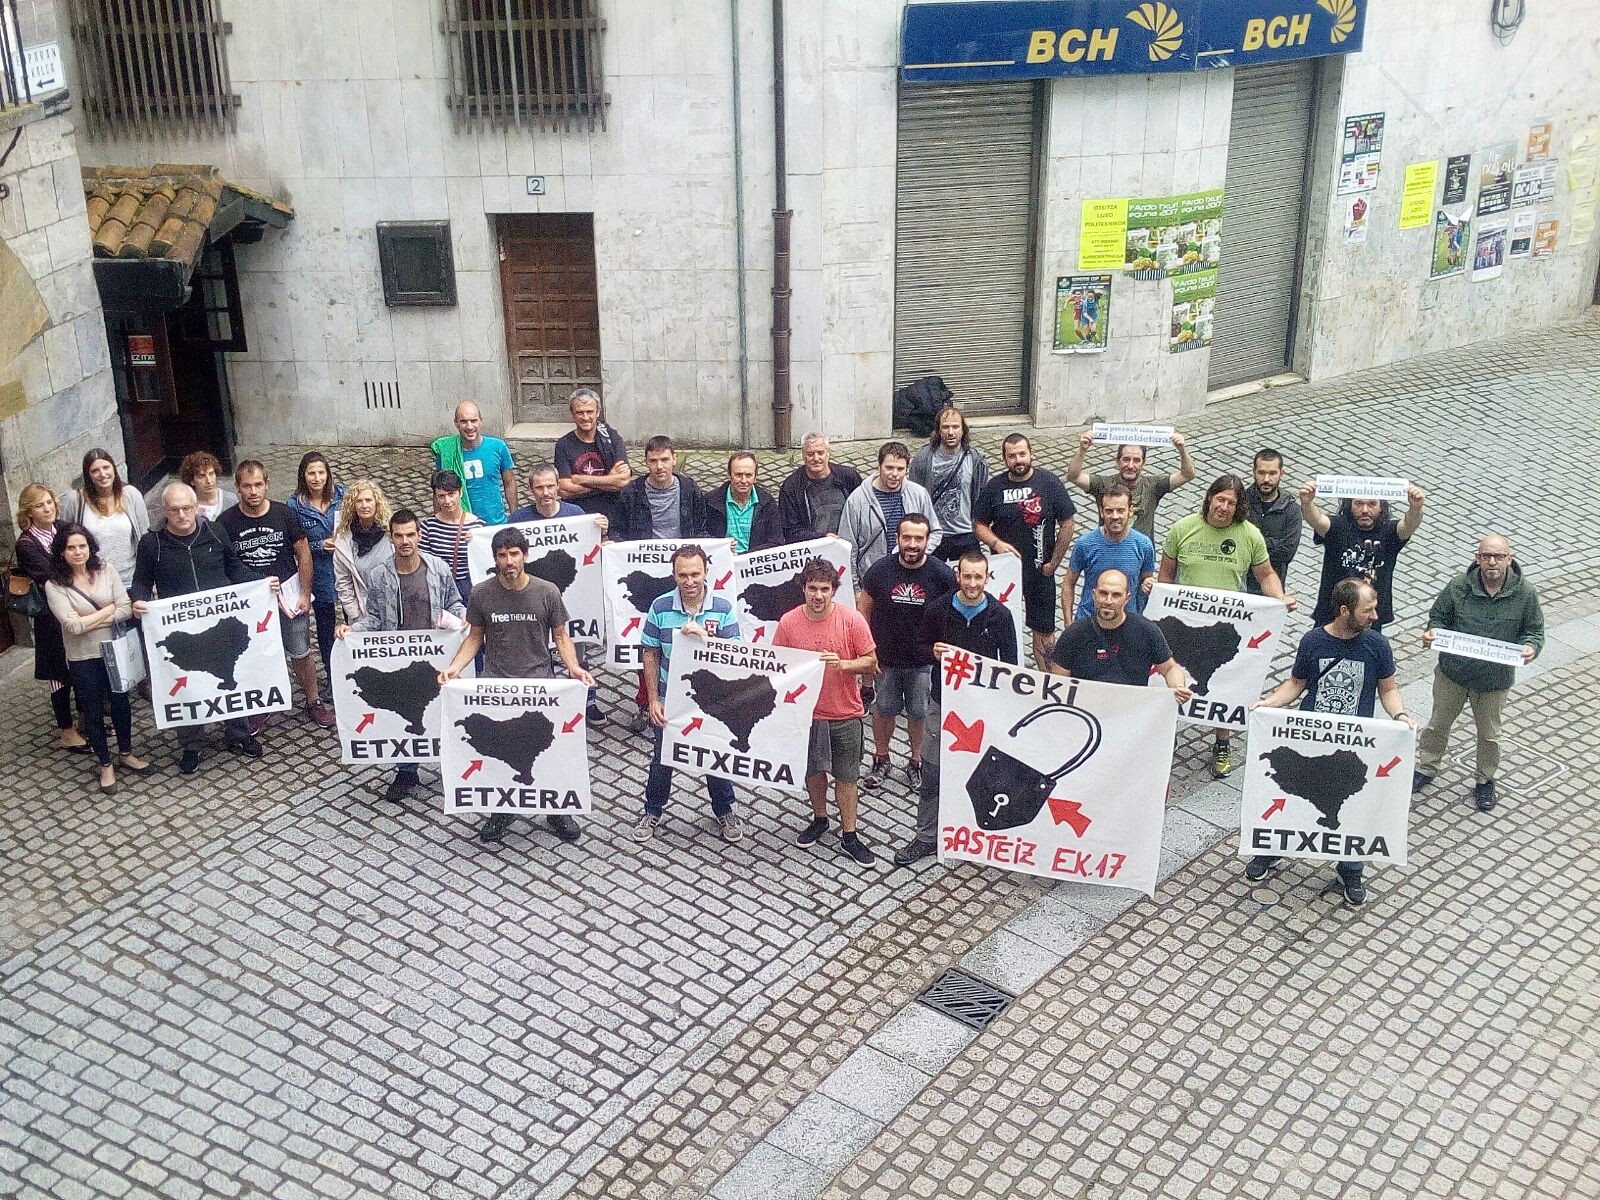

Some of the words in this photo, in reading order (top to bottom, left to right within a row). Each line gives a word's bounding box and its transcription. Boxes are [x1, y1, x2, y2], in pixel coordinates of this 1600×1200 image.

[1242, 14, 1312, 51] BCH
[1026, 28, 1119, 63] BCH
[531, 179, 541, 191] 2
[1002, 487, 1032, 502] KOP
[545, 524, 566, 533] ETA
[232, 531, 284, 551] OREGON
[749, 551, 787, 565] PRESO
[790, 547, 812, 558] ETA
[171, 596, 211, 611] PRESO
[215, 591, 238, 603] ETA
[1178, 588, 1219, 602] PRESO
[1222, 596, 1245, 607] ETA
[161, 599, 251, 626] IHESLARIAK
[491, 613, 510, 623] free
[1163, 596, 1254, 622] IHESLARIAK
[363, 635, 405, 646] PRESO
[408, 634, 433, 643] ETA
[706, 641, 749, 654] PRESO
[752, 648, 776, 659] ETA
[352, 644, 446, 660] IHESLARIAK
[693, 649, 788, 674] IHESLARIAK
[944, 651, 1080, 706] #ireki
[476, 684, 519, 694] PRESO
[523, 685, 547, 695] ETA
[164, 686, 285, 722] ETXERA
[463, 694, 560, 707] IHESLARIAK
[1286, 716, 1333, 730] PRESO
[1337, 722, 1363, 733] ETA
[1272, 726, 1376, 749] IHESLARIAK
[672, 742, 795, 786] ETXERA
[455, 787, 582, 810] ETXERA
[1252, 827, 1390, 857] ETXERA
